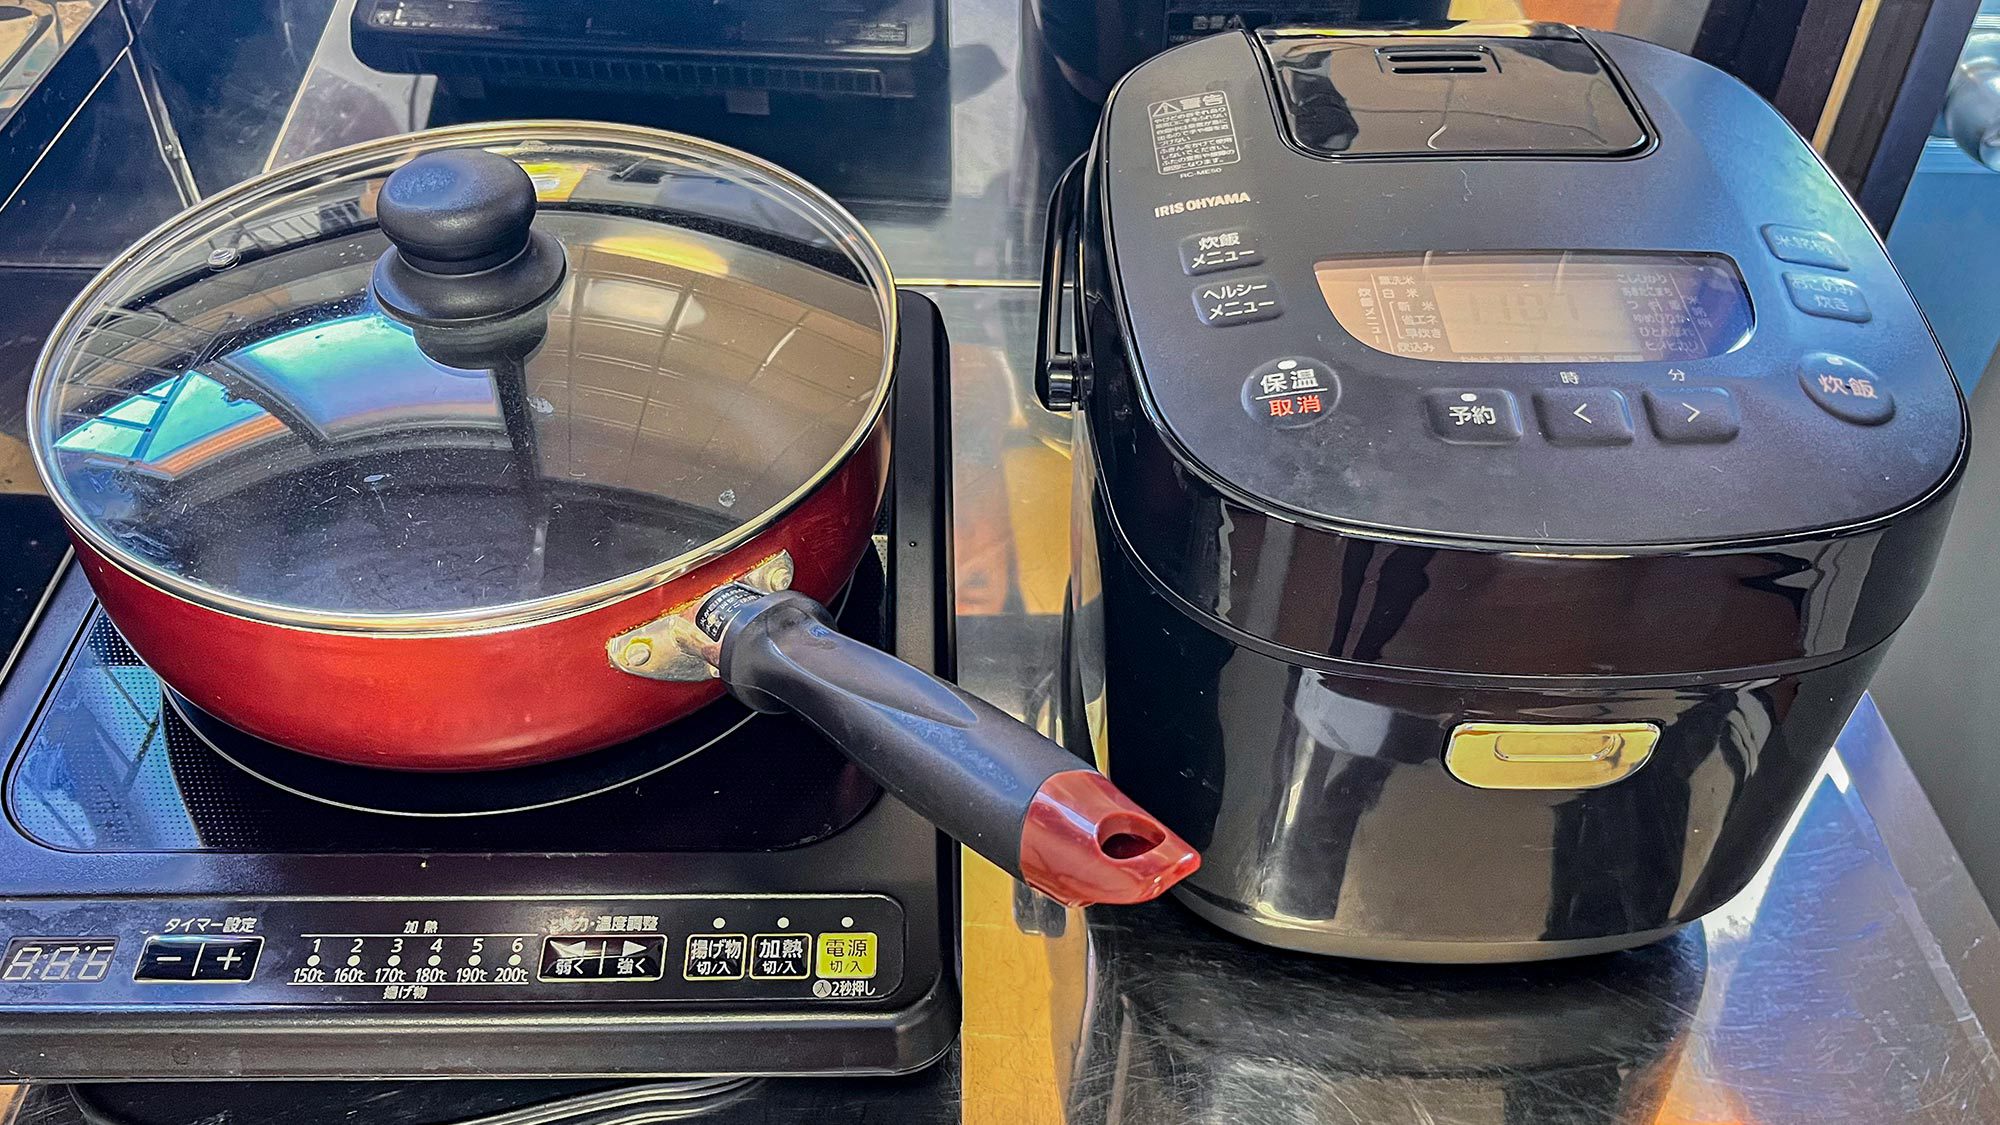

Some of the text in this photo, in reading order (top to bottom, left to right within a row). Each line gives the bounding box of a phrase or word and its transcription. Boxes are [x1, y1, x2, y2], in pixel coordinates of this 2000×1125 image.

[1180, 94, 1224, 110] 警告
[1154, 192, 1250, 218] IRIS OHYAMA
[1199, 232, 1240, 250] 炊飯
[1192, 250, 1254, 268] メニュー
[1203, 284, 1268, 300] ヘルシー
[1208, 300, 1274, 320] メニュー
[1814, 294, 1849, 312] 炊き
[1402, 314, 1438, 326] 省エネ
[1405, 328, 1441, 339] 早炊き
[1260, 368, 1318, 394] 保温
[1560, 371, 1580, 385] 時
[1668, 368, 1686, 382] 分
[1818, 372, 1878, 400] 炊飯
[1269, 394, 1321, 417] 取消
[1449, 405, 1496, 426] 予約
[164, 916, 258, 933] タイマー設定
[403, 920, 438, 934] 加熱
[312, 938, 524, 953] 1 2 3 4 5 6
[691, 938, 742, 960] 揚げ物
[759, 938, 804, 960] 加熱
[825, 938, 868, 958] 電源
[556, 958, 584, 975] 弱く
[616, 958, 646, 975] 強く
[696, 960, 731, 976] 切/入
[762, 960, 797, 975] 切/入
[382, 985, 428, 1000] 揚げ物
